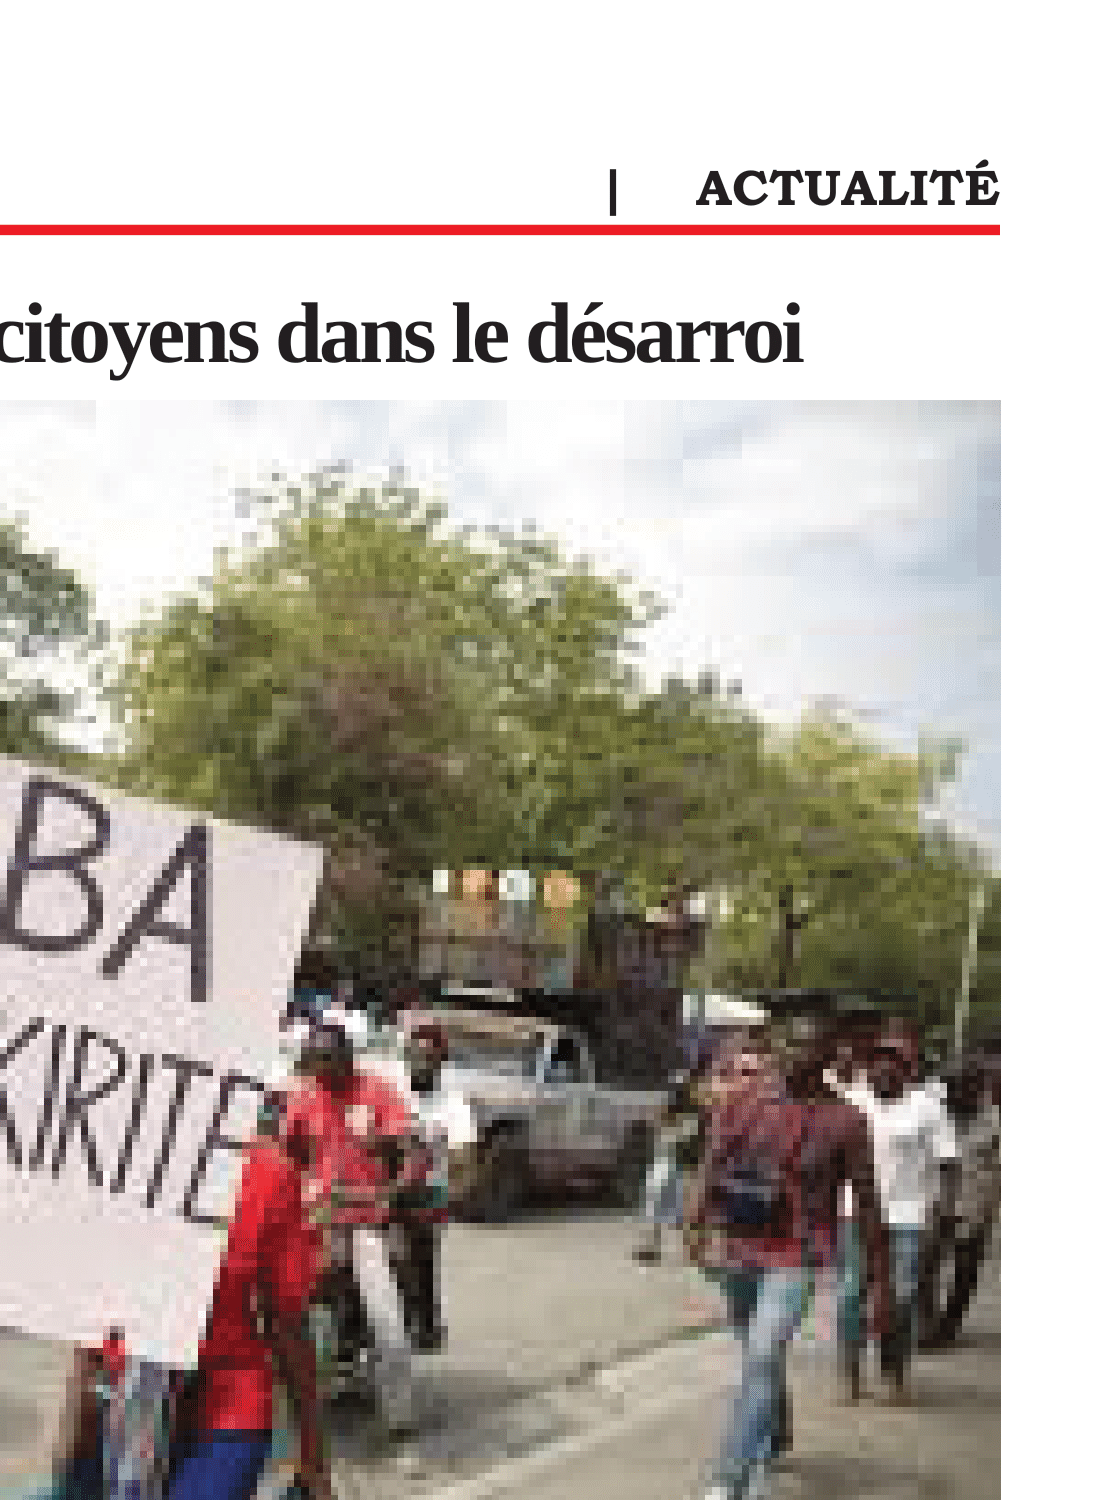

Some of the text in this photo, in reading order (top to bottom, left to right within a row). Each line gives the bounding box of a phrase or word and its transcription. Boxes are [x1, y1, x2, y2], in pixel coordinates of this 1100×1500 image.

[695, 159, 1001, 207] ACTUALITÉ
[278, 301, 435, 364] dans
[452, 301, 509, 364] le
[528, 301, 805, 364] désarroi
